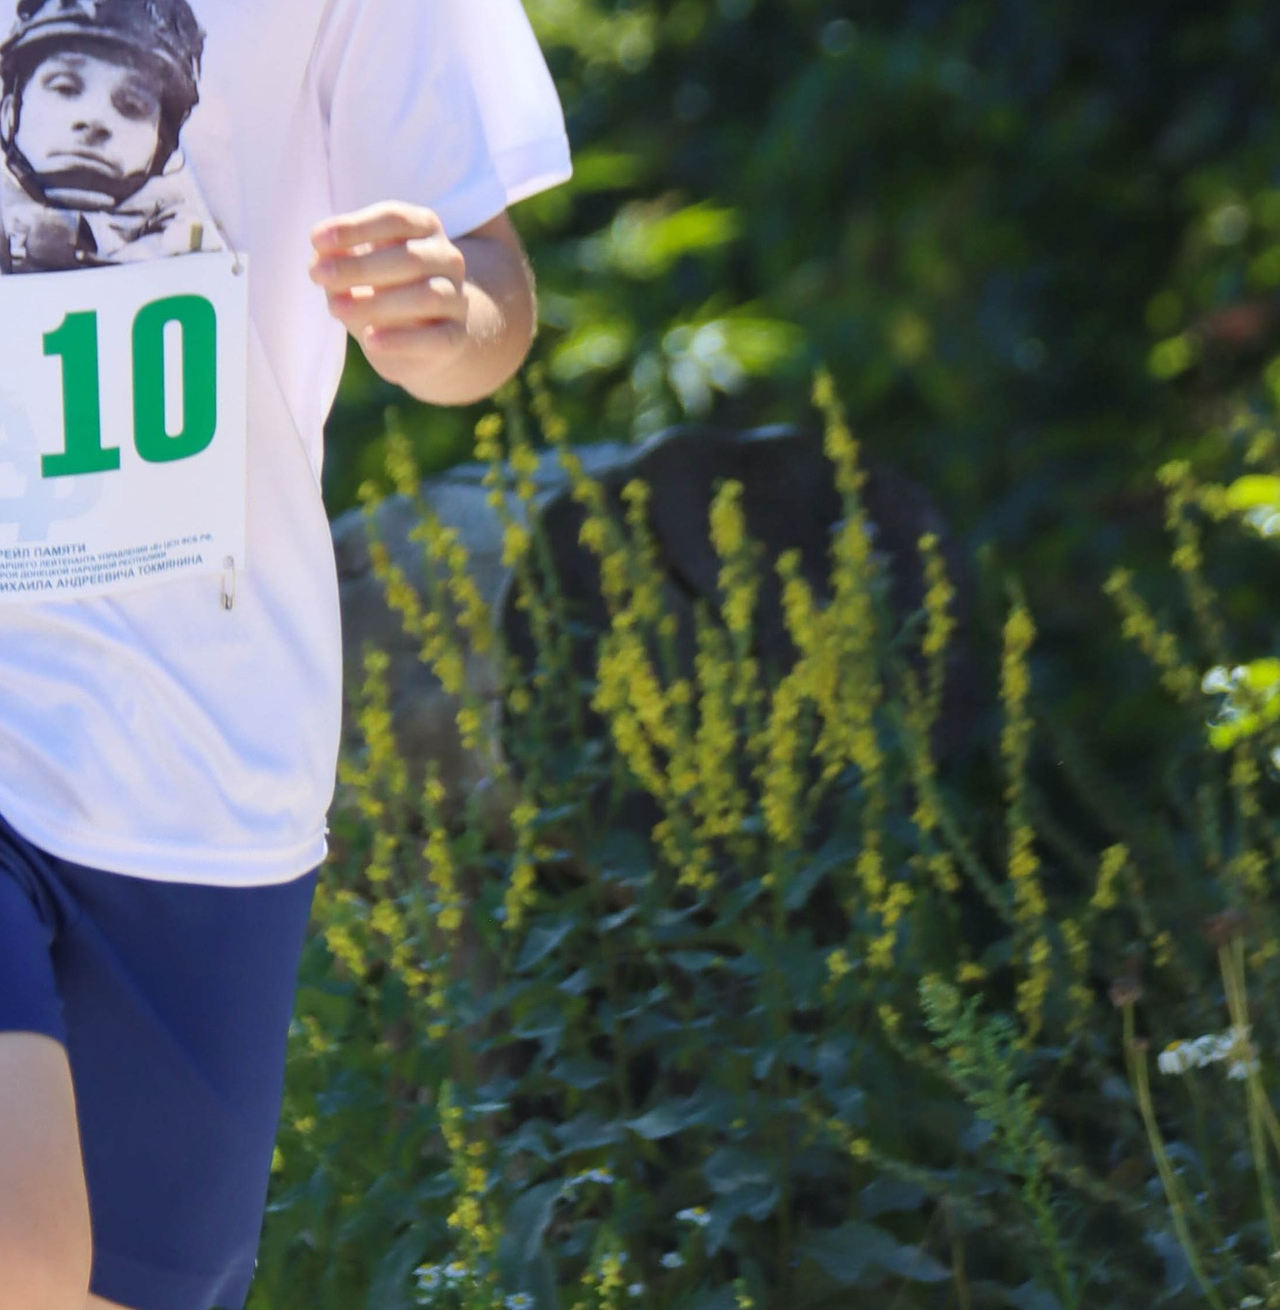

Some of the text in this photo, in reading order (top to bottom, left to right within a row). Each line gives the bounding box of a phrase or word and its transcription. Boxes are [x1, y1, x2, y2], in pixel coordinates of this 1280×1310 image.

[41, 294, 217, 478] 10
[34, 543, 86, 558] ПАМЯТИ
[40, 554, 96, 568] ЛЕЙТЕНАНТА
[20, 566, 69, 579] ДОНЕЦКОЙ
[57, 568, 135, 589] АНДРЕЕВИЧА
